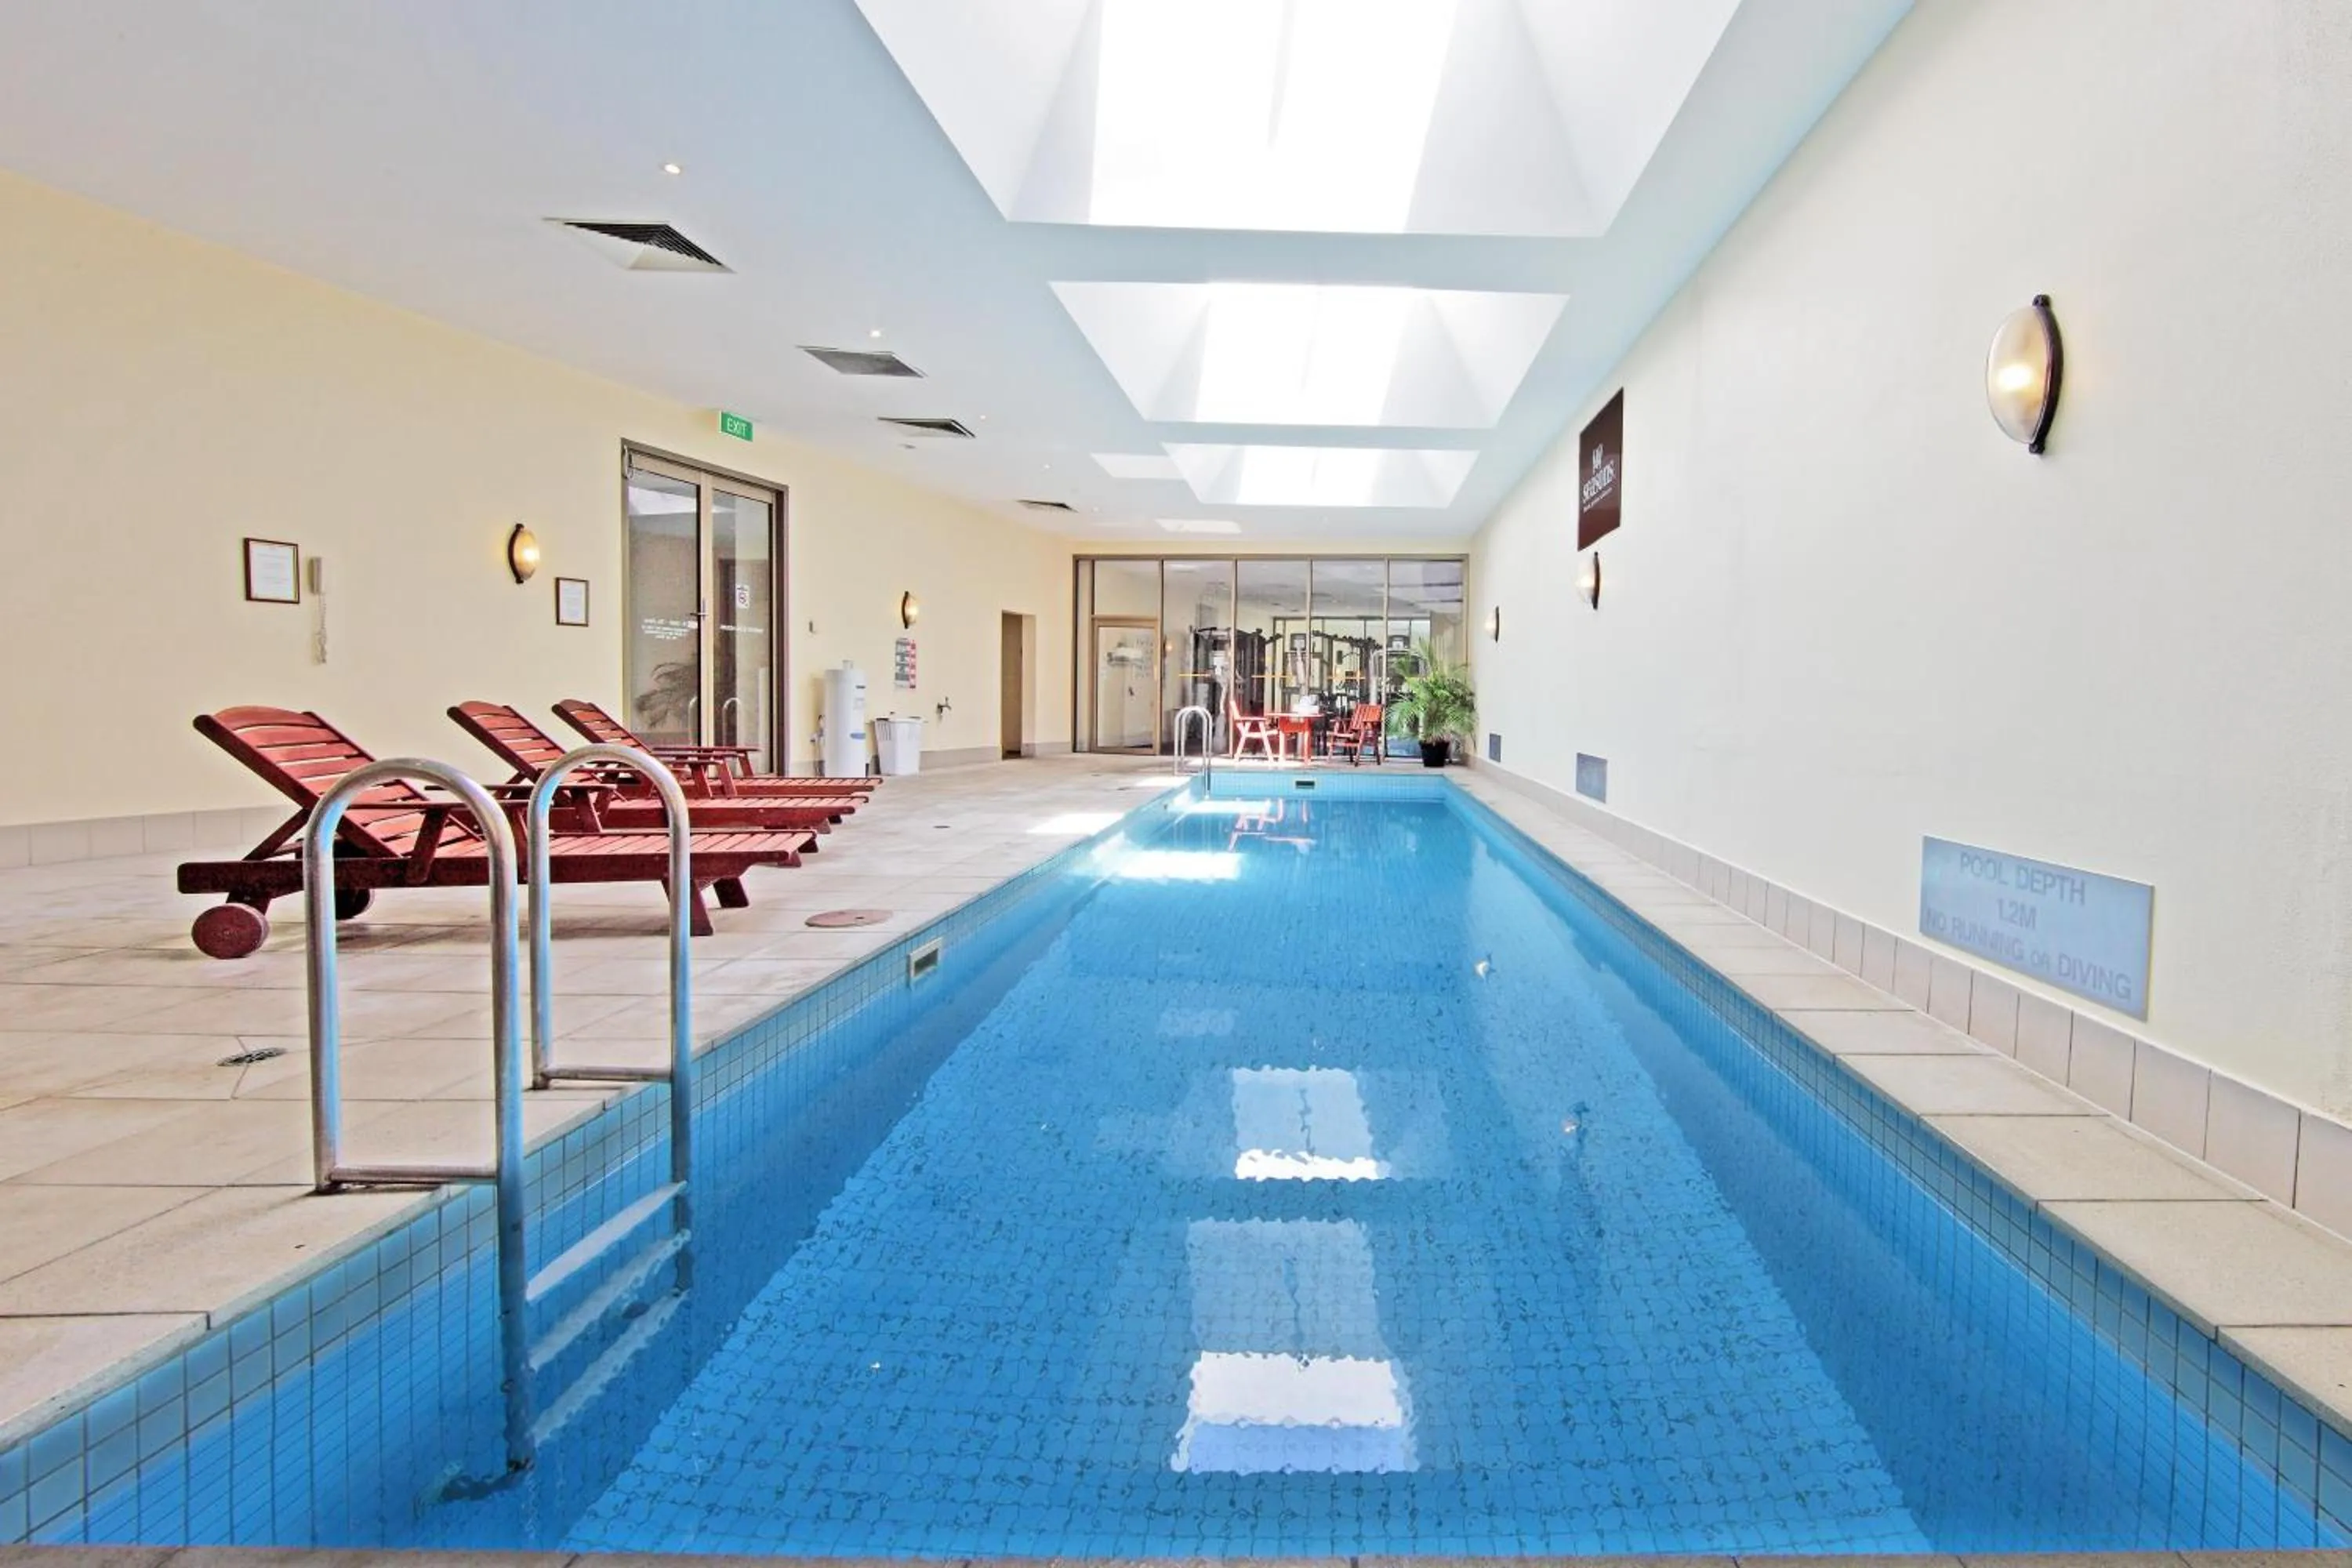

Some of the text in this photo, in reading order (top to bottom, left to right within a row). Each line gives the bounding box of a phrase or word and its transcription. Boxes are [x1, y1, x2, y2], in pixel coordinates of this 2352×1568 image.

[727, 416, 747, 437] EXIT
[1960, 851, 2085, 906] POOL DEPTH
[1926, 906, 1945, 931] NO
[1951, 916, 2024, 961] RUNNING
[2058, 953, 2132, 1001] DIVING
